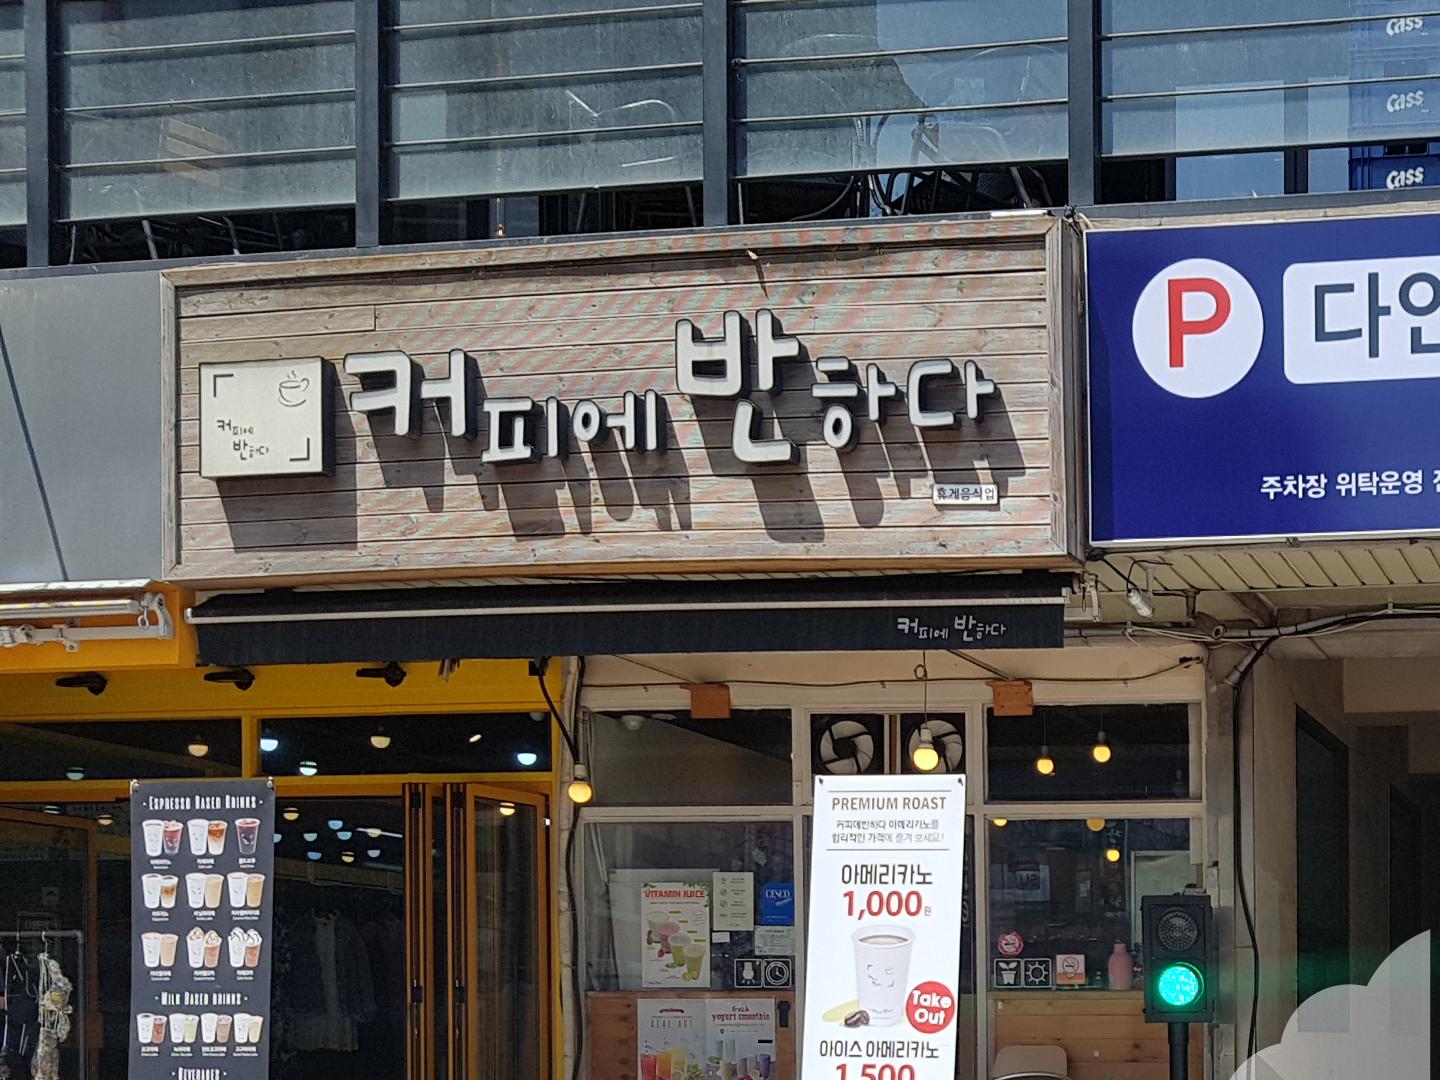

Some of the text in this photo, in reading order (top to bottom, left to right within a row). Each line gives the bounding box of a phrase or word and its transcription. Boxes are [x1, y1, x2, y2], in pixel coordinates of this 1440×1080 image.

[1385, 89, 1425, 113] Cass
[1385, 166, 1425, 190] Cass
[344, 309, 996, 466] 커피에 반하다
[936, 486, 994, 500] 휴게음식업
[1260, 473, 1326, 500] 주차장
[1335, 469, 1424, 498] 위탁운영
[897, 614, 1007, 642] 커피에 반하다
[831, 796, 947, 811] PREMIUM ROAST
[840, 863, 933, 885] 아메리카노
[912, 989, 952, 1010] Take
[914, 1010, 947, 1026] Out
[819, 1040, 940, 1059] 아이스 아메리카노
